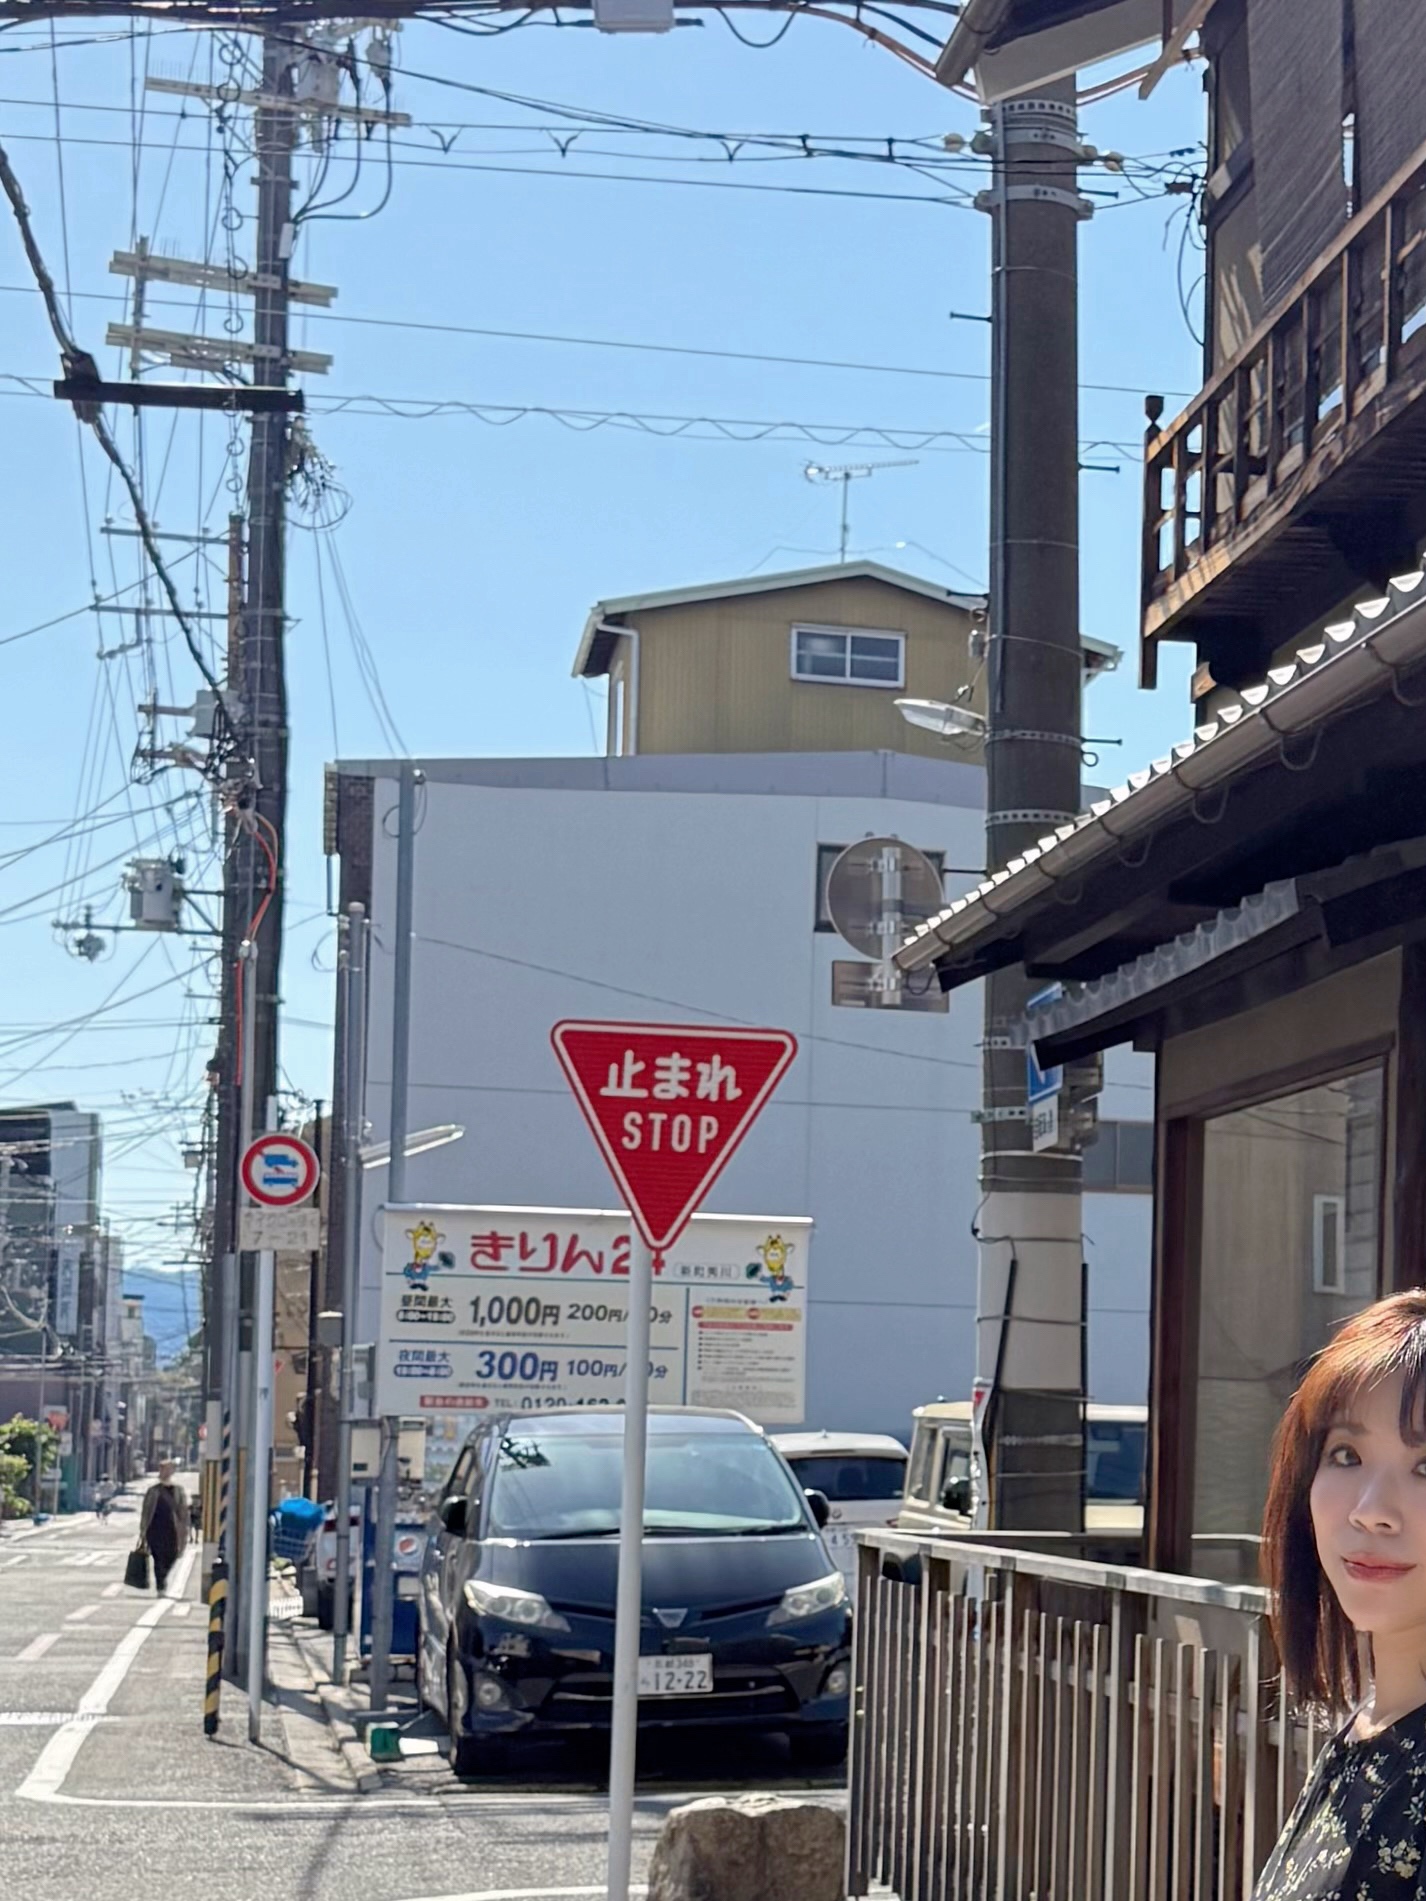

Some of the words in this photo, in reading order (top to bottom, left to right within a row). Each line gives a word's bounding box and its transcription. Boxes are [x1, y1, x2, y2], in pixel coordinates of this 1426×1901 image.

[600, 1050, 742, 1102] 止まれ
[622, 1112, 719, 1153] STOP
[470, 1295, 560, 1327] 1,000円
[567, 1304, 673, 1324] 200円/0分
[476, 1350, 558, 1382] 300円
